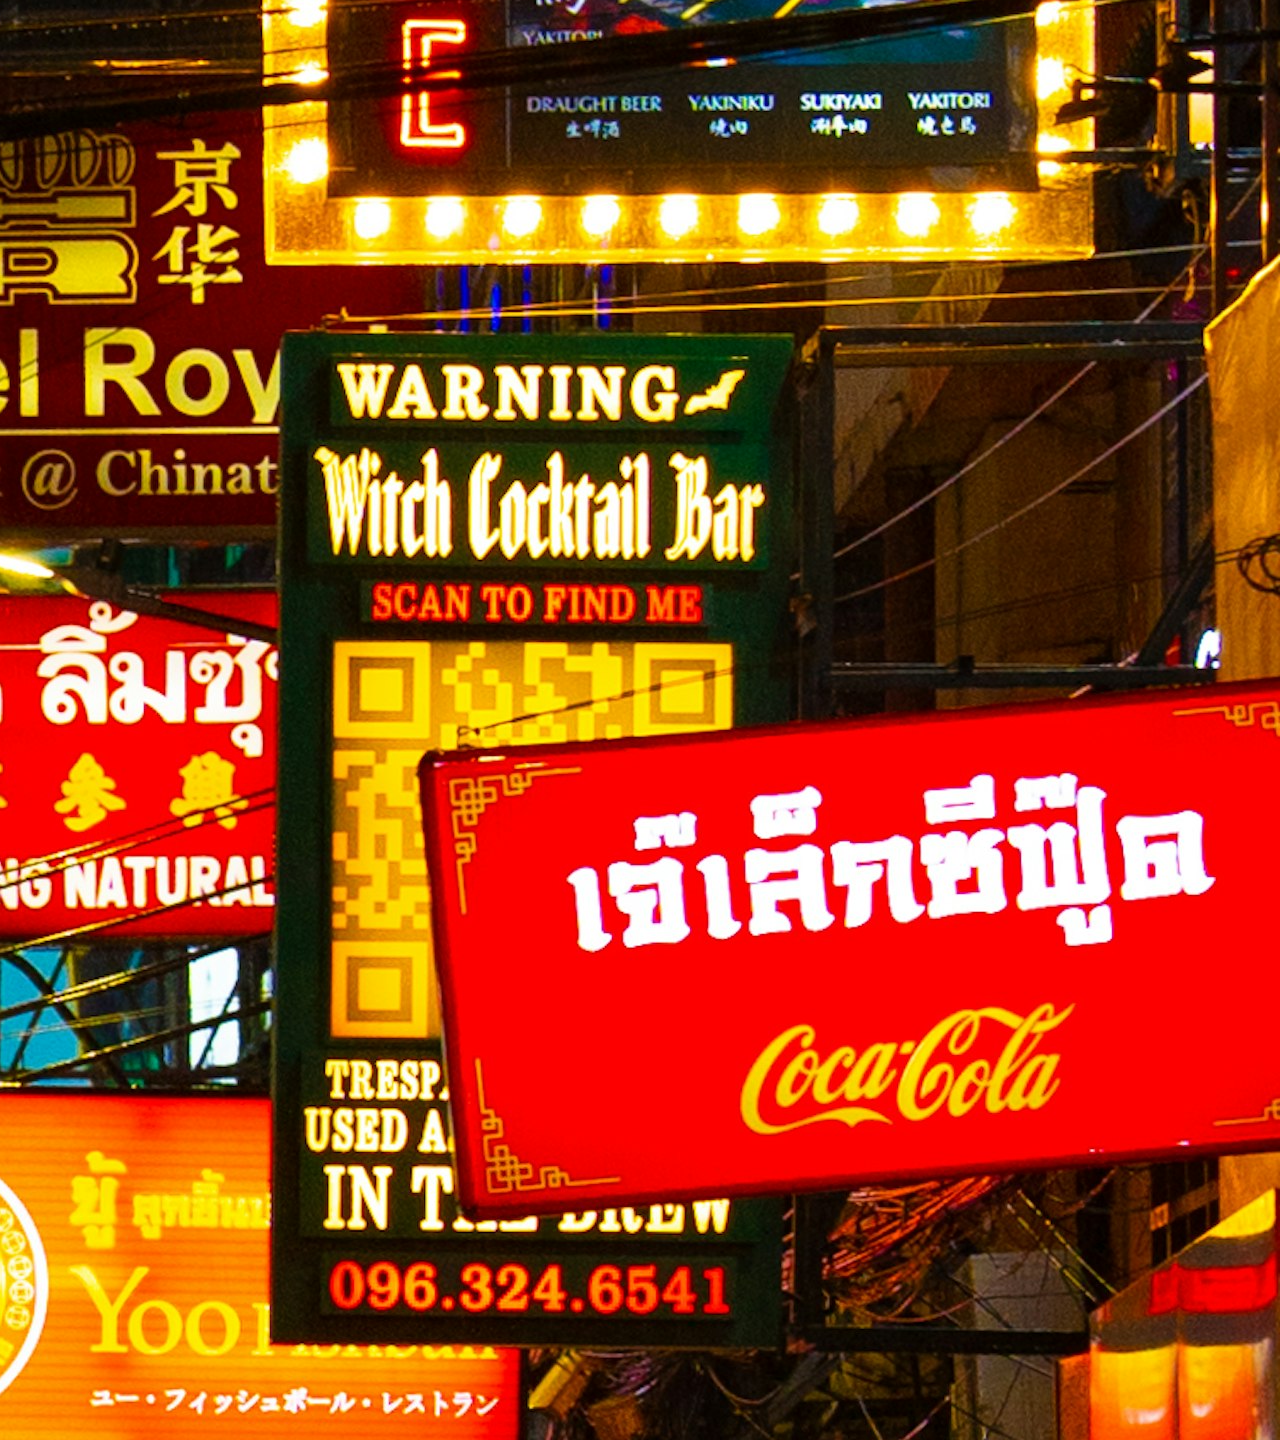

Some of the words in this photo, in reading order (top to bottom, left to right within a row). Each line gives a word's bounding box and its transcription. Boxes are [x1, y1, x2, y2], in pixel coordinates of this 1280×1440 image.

[526, 95, 618, 113] DRAUGHT
[621, 95, 663, 113] BEER
[688, 94, 775, 112] YAKINIKU
[800, 93, 883, 111] SUKIYAKI
[908, 91, 992, 110] YAKITORI
[84, 326, 280, 424] Roy
[337, 363, 682, 422] WARNING
[21, 449, 78, 510] @
[315, 445, 452, 558] Witch
[468, 451, 652, 561] Cocktail
[665, 451, 765, 563] Bar
[371, 582, 472, 623] SCAN
[480, 584, 533, 623] TO
[543, 585, 636, 624] FIND
[644, 585, 704, 625] ME
[37, 601, 278, 757] ลิ้มซุ
[63, 856, 274, 910] NATURAL
[739, 1002, 1076, 1136] Coca-Cola
[303, 1106, 408, 1153] USED
[417, 1108, 455, 1154] A
[323, 1164, 393, 1231] IN
[69, 1263, 241, 1357] Yoo
[328, 1259, 731, 1316] 096.324.6541
